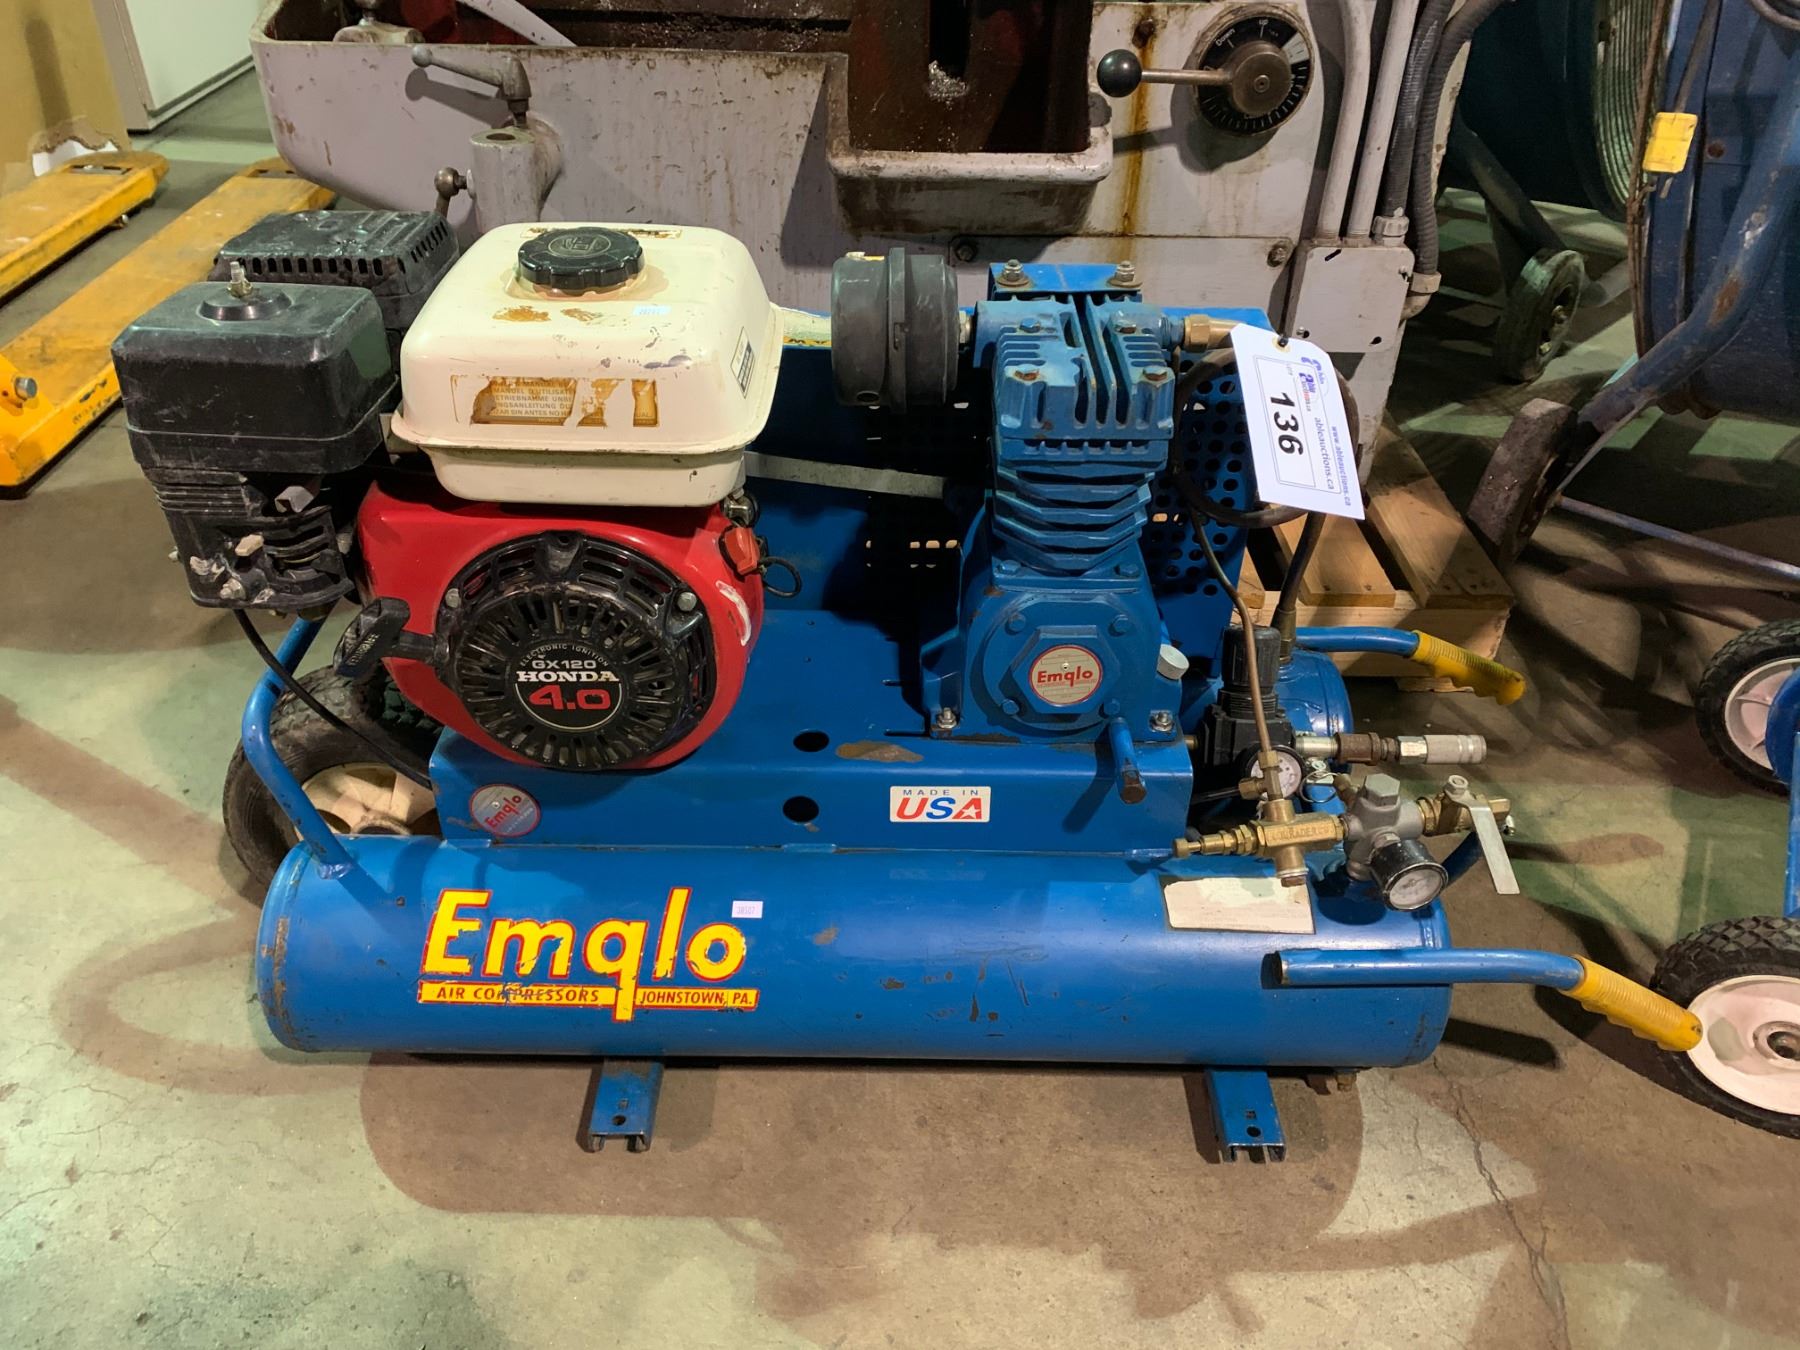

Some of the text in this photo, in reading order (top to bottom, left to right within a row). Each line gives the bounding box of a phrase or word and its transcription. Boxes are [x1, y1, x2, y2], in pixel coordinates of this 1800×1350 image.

[1270, 391, 1304, 455] 136
[1315, 416, 1335, 490] ableauctions.ca
[520, 643, 609, 667] ELECTRONIC IGNITION
[531, 660, 597, 669] GX120
[516, 671, 619, 682] HONDA
[529, 684, 611, 710] 4.0
[896, 797, 982, 820] USA
[437, 987, 466, 1000] AIR
[732, 992, 753, 1004] PA.
